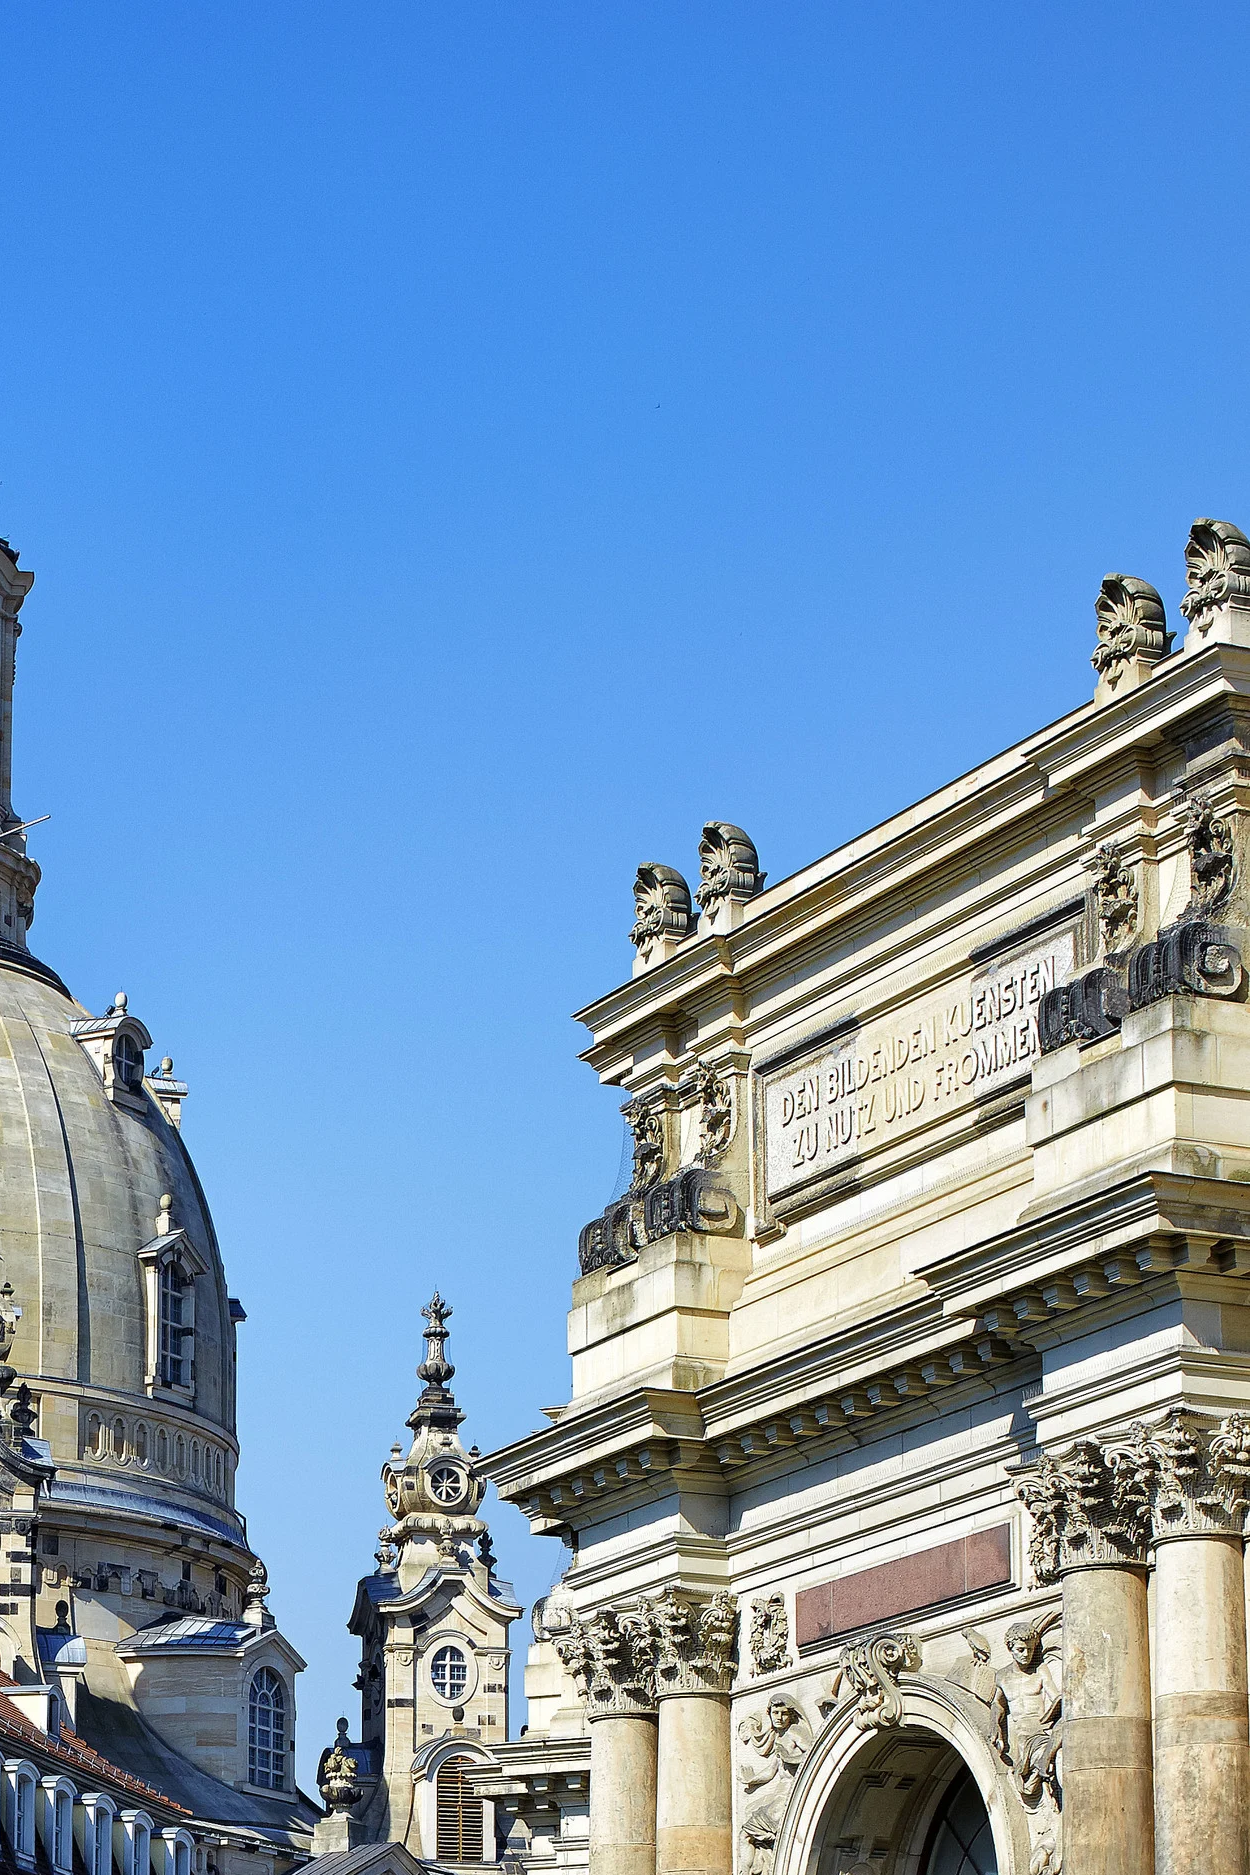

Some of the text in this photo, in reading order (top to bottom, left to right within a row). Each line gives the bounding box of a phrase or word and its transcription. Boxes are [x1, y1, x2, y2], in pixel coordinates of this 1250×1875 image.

[782, 956, 1056, 1128] DEN BILDENDEN KUENSTEN
[792, 1015, 1043, 1169] ZU NUTZ UND FROMMEN
